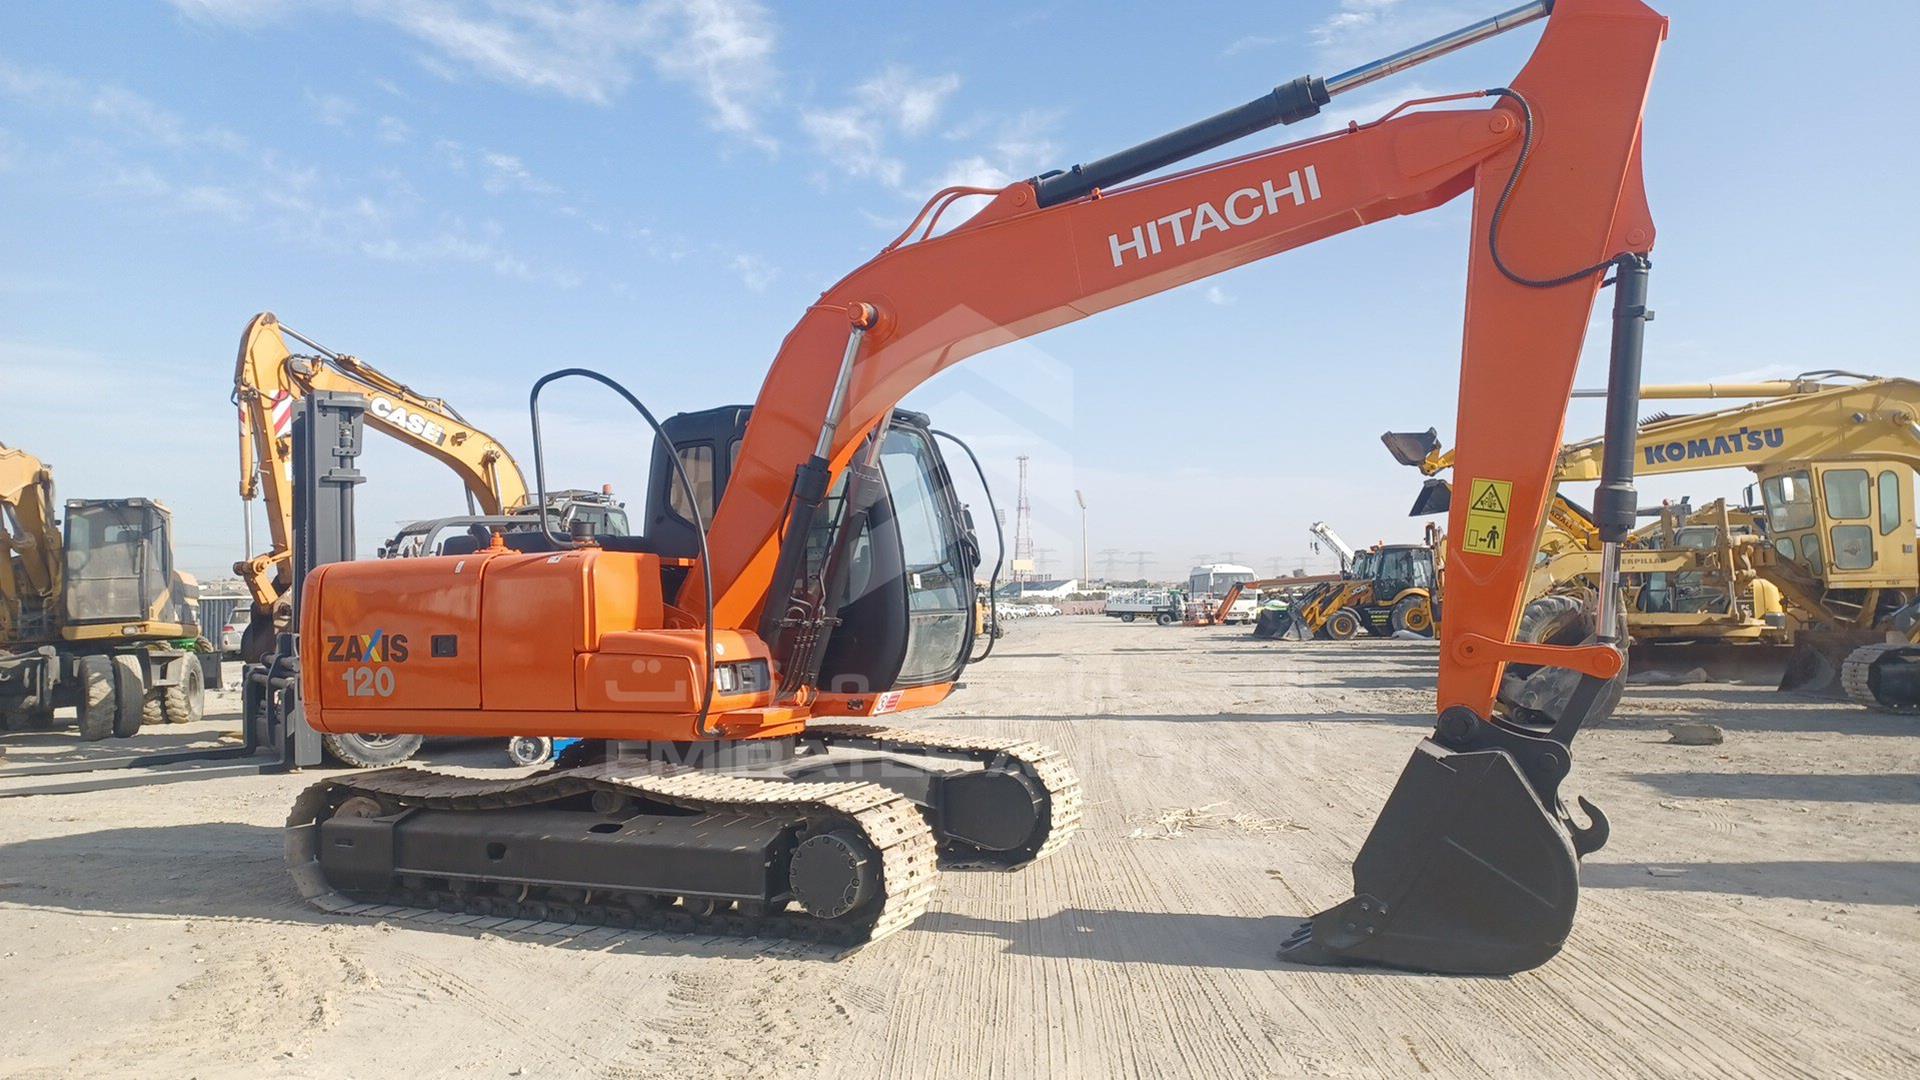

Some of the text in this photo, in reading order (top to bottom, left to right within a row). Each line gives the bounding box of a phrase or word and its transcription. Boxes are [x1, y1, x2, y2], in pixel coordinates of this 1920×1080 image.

[1108, 164, 1322, 267] HITACHI
[371, 397, 442, 443] CASE
[1644, 427, 1784, 465] KOMATSU
[327, 628, 409, 664] ZAXIS
[341, 666, 396, 698] 120
